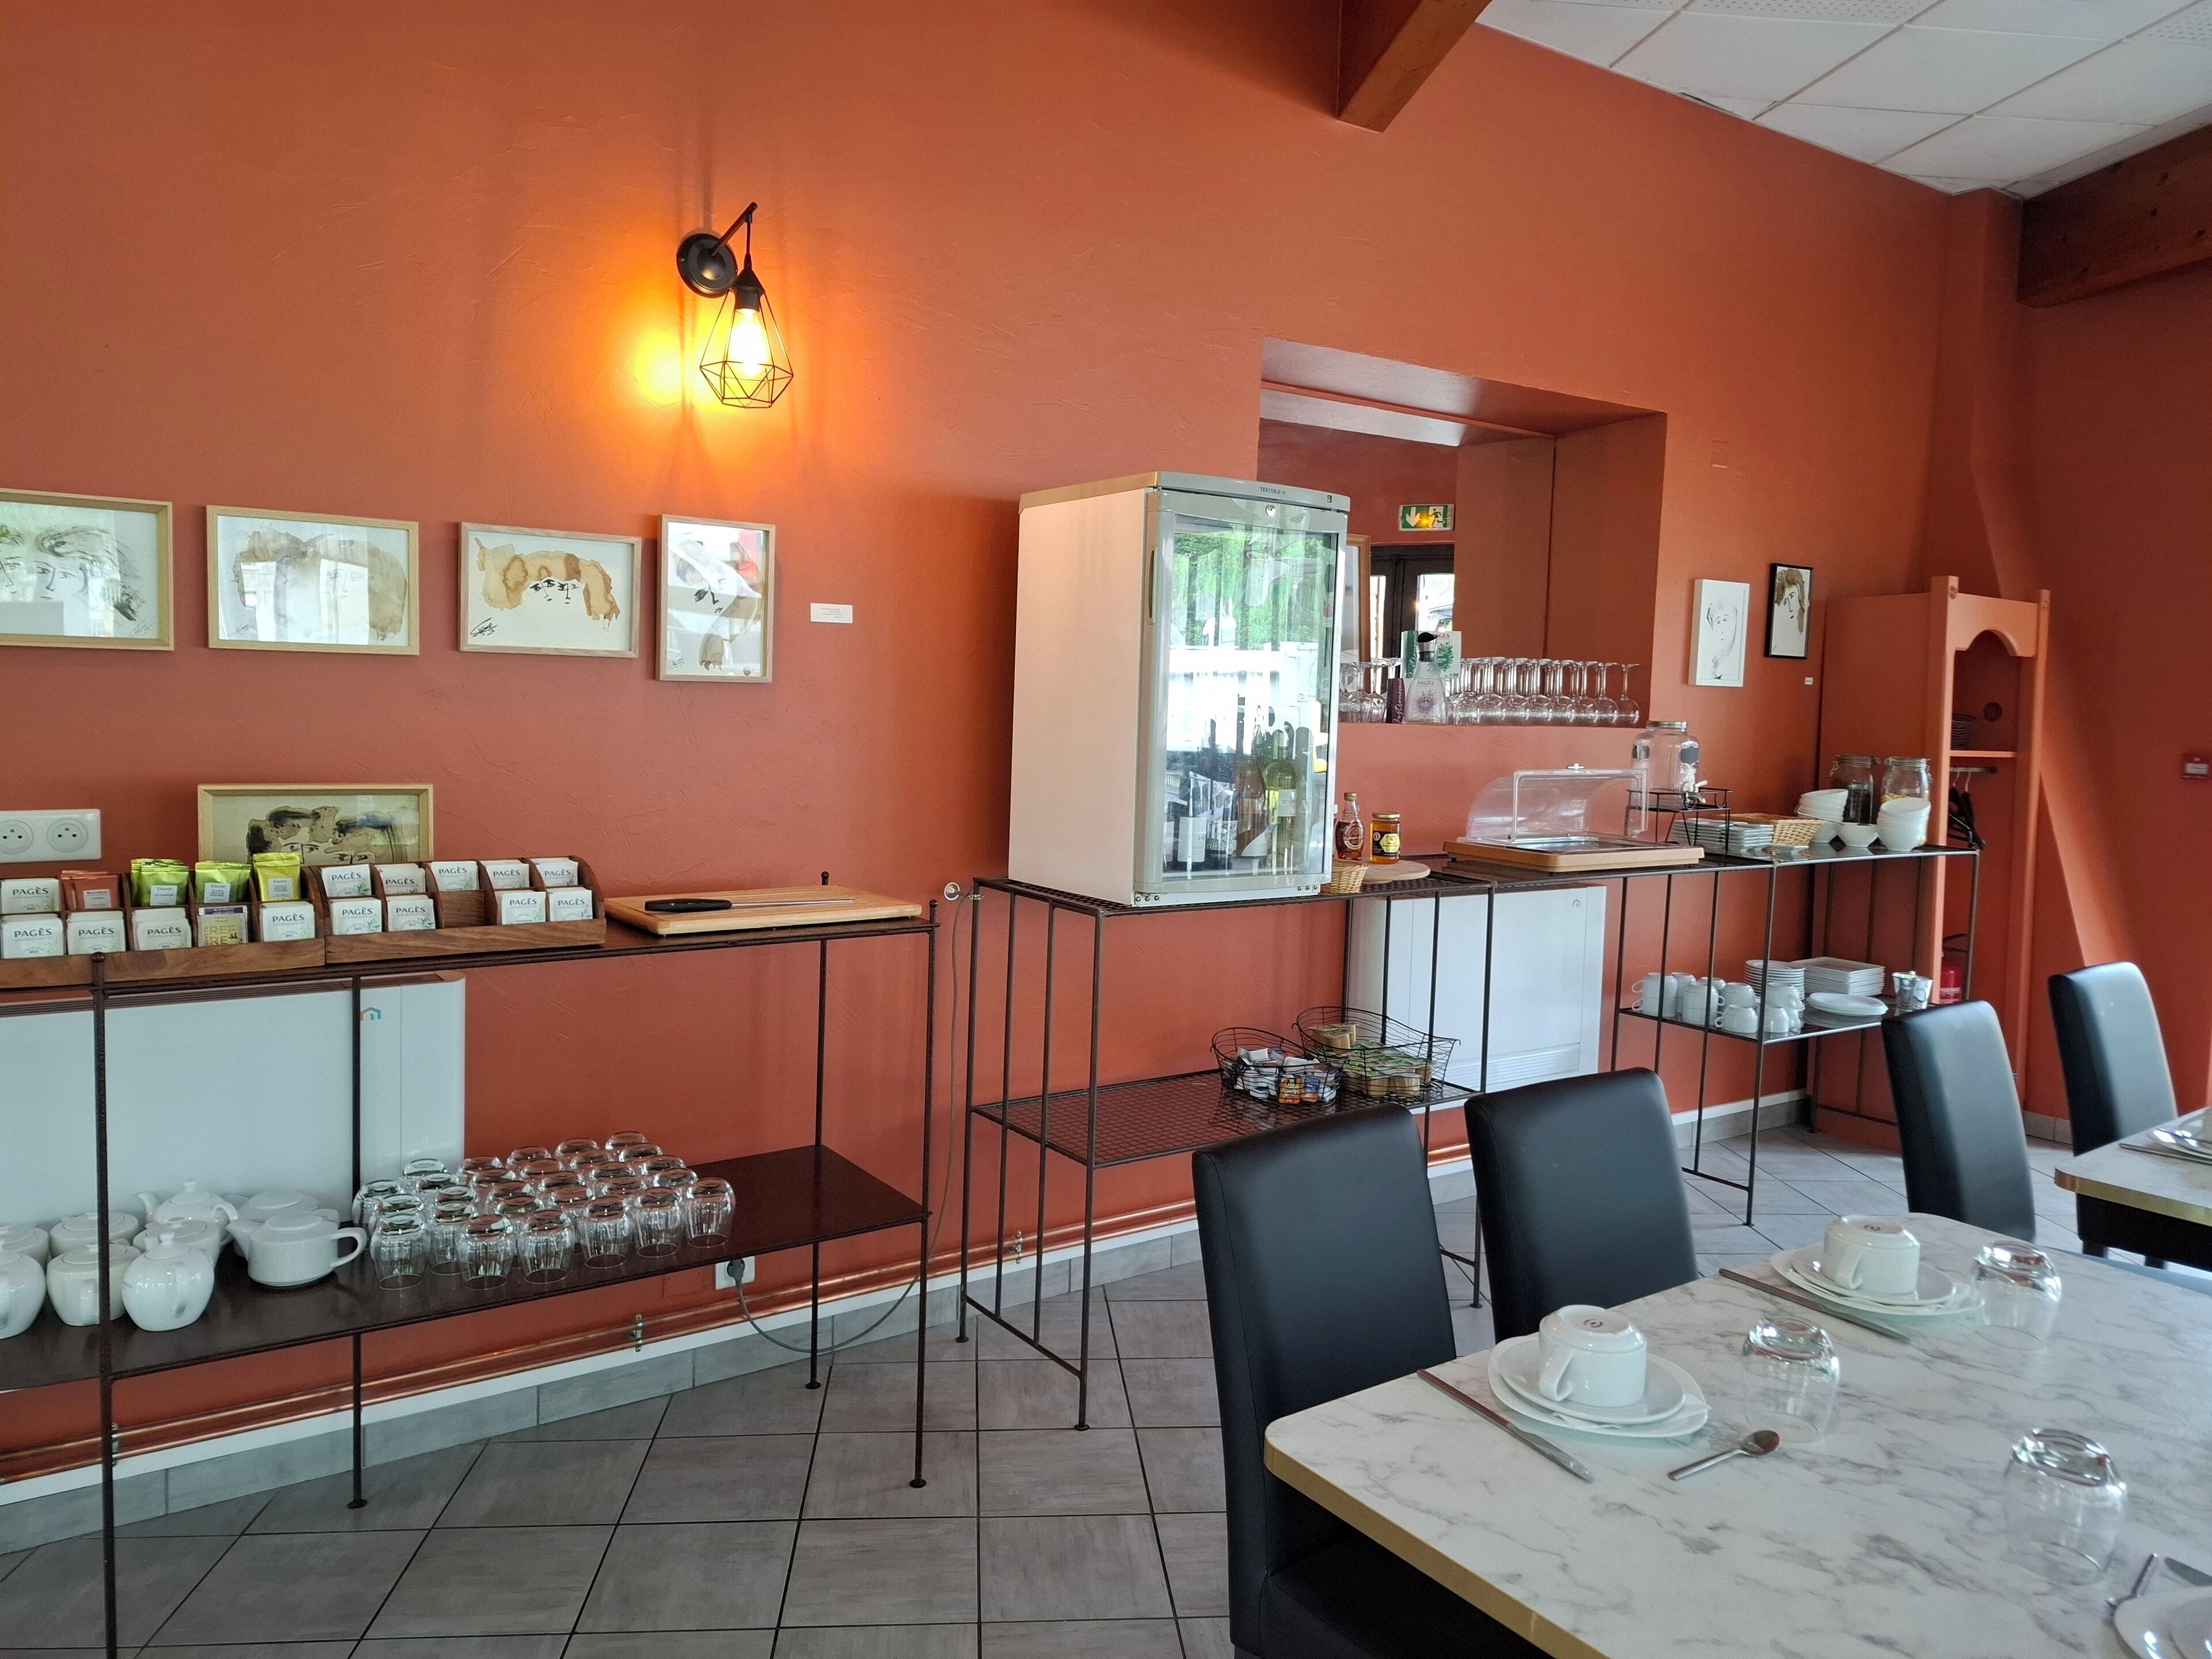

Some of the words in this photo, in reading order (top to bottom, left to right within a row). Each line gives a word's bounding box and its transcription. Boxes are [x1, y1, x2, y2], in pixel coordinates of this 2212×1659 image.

[438, 866, 467, 874] PAGÈS
[493, 869, 520, 877] PAGÈS
[331, 872, 361, 881] PAGÈS
[385, 877, 415, 885] PAGÈS
[12, 887, 48, 896] PAGÈS
[509, 897, 537, 906] PAGÈS
[558, 898, 585, 906] PAGÈS
[342, 907, 373, 916] PAGÈS
[272, 913, 304, 922] PAGÈS
[14, 927, 52, 938] PAGÈS
[78, 927, 114, 936] PAGÈS
[147, 926, 181, 935] PAGÈS
